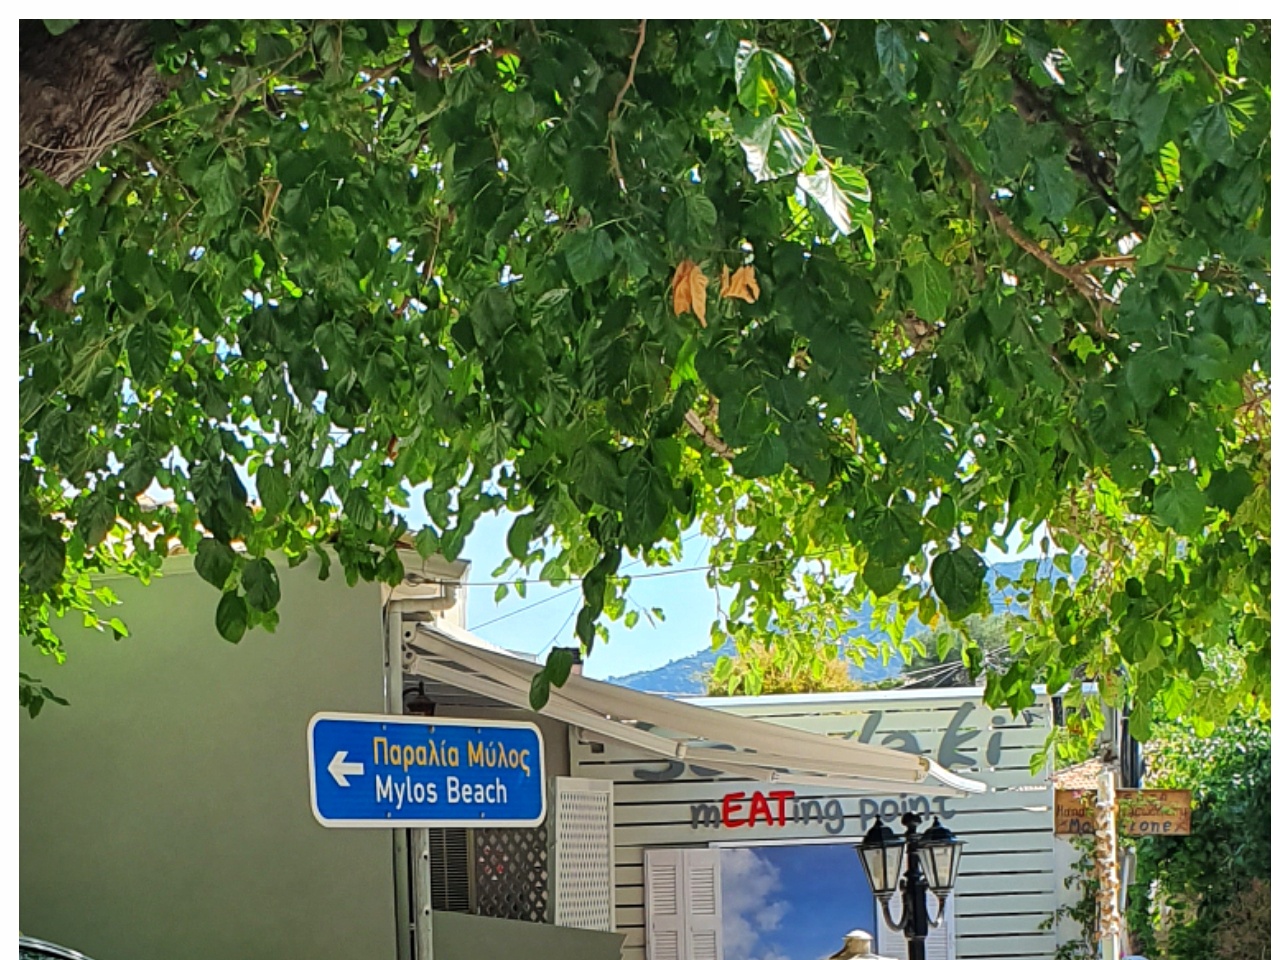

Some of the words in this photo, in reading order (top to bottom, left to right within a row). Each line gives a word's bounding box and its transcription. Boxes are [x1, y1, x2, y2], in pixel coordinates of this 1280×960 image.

[373, 737, 459, 772] Παραλία
[468, 740, 531, 777] Μύλος
[375, 775, 438, 810] Mylos
[446, 776, 508, 804] Beach
[691, 790, 844, 834] mEATing
[860, 793, 956, 832] point
